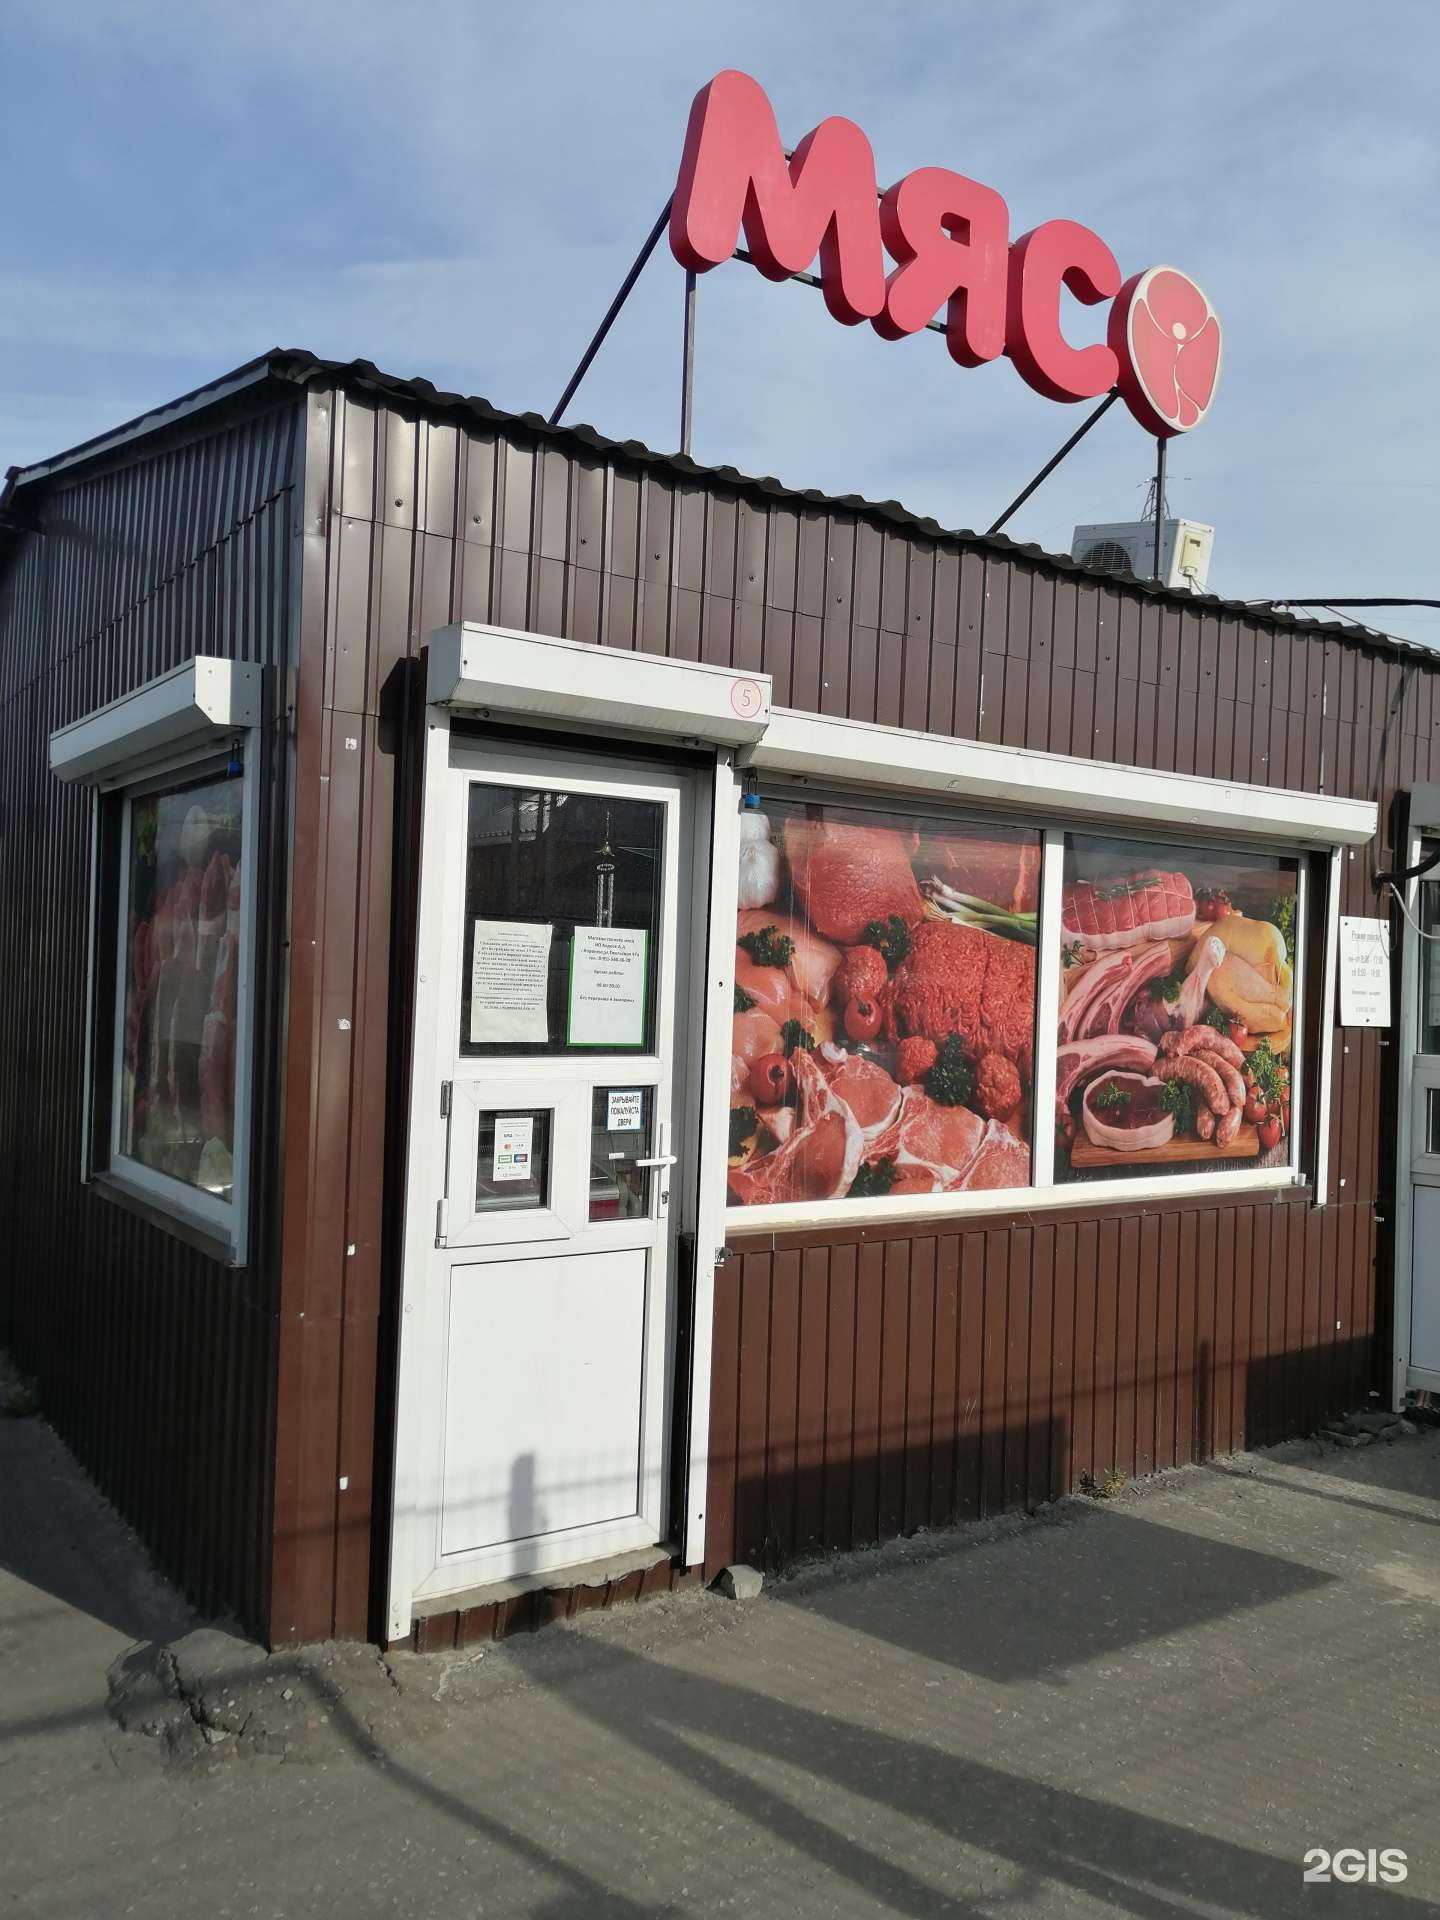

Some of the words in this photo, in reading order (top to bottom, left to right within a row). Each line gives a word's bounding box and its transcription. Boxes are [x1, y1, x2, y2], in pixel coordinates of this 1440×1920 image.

[741, 689, 752, 707] 5
[610, 1106, 640, 1115] ПОЖАЛУЙСТА
[617, 1118, 632, 1127] ДВЕРИ
